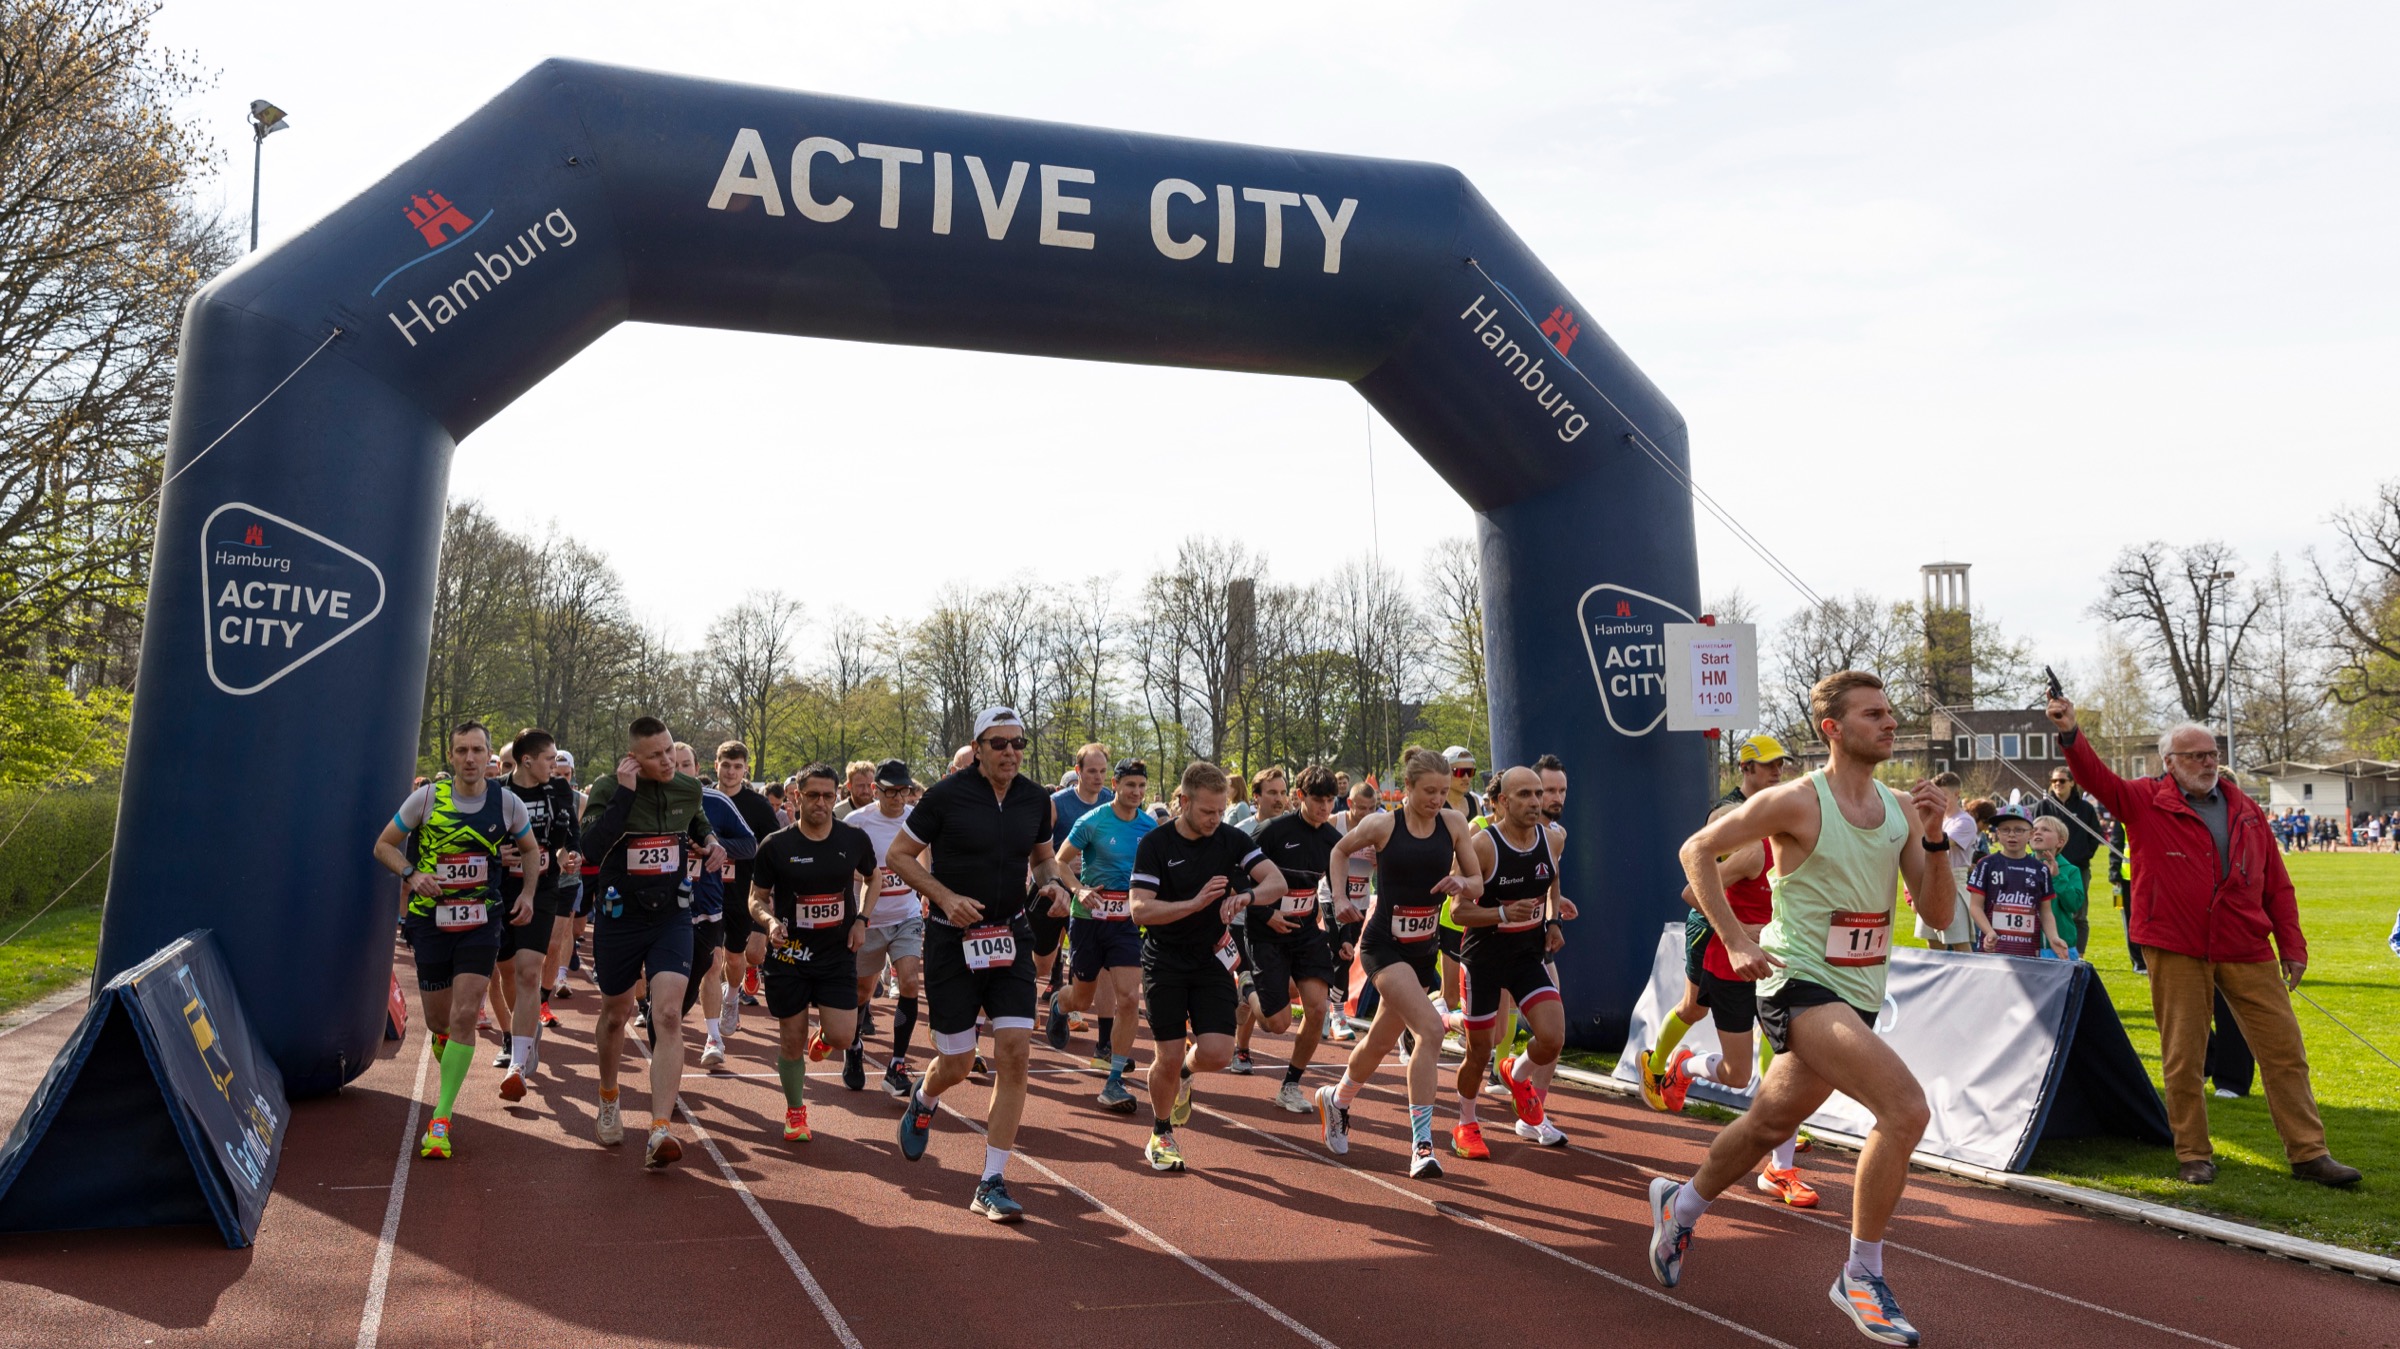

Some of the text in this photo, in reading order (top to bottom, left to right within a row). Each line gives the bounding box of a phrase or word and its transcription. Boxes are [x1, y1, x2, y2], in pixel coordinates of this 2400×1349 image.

[707, 127, 1359, 274] ACTIVE CITY
[388, 207, 578, 347] Hamburg
[1460, 294, 1590, 443] Hamburg
[215, 550, 291, 573] Hamburg
[217, 579, 351, 620] ACTIVE
[219, 615, 304, 649] CITY
[1594, 623, 1653, 636] Hamburg
[1604, 644, 1665, 669] ACTI
[1701, 653, 1730, 665] Start
[1610, 672, 1667, 698] CITY
[1702, 670, 1727, 686] HM
[1698, 691, 1733, 705] 11:00
[639, 847, 669, 864] 233
[447, 864, 478, 879] 340
[1991, 870, 2004, 885] 31
[1103, 900, 1123, 912] 133
[1293, 898, 1308, 909] 17
[1996, 890, 2034, 906] baltic
[449, 905, 480, 921] 13 1
[802, 903, 840, 919] 1958
[1398, 915, 1435, 932] 1948
[2005, 914, 2031, 928] 18 3
[970, 937, 1013, 957] 1049
[1849, 928, 1884, 951] 11 1
[783, 946, 814, 961] 42k
